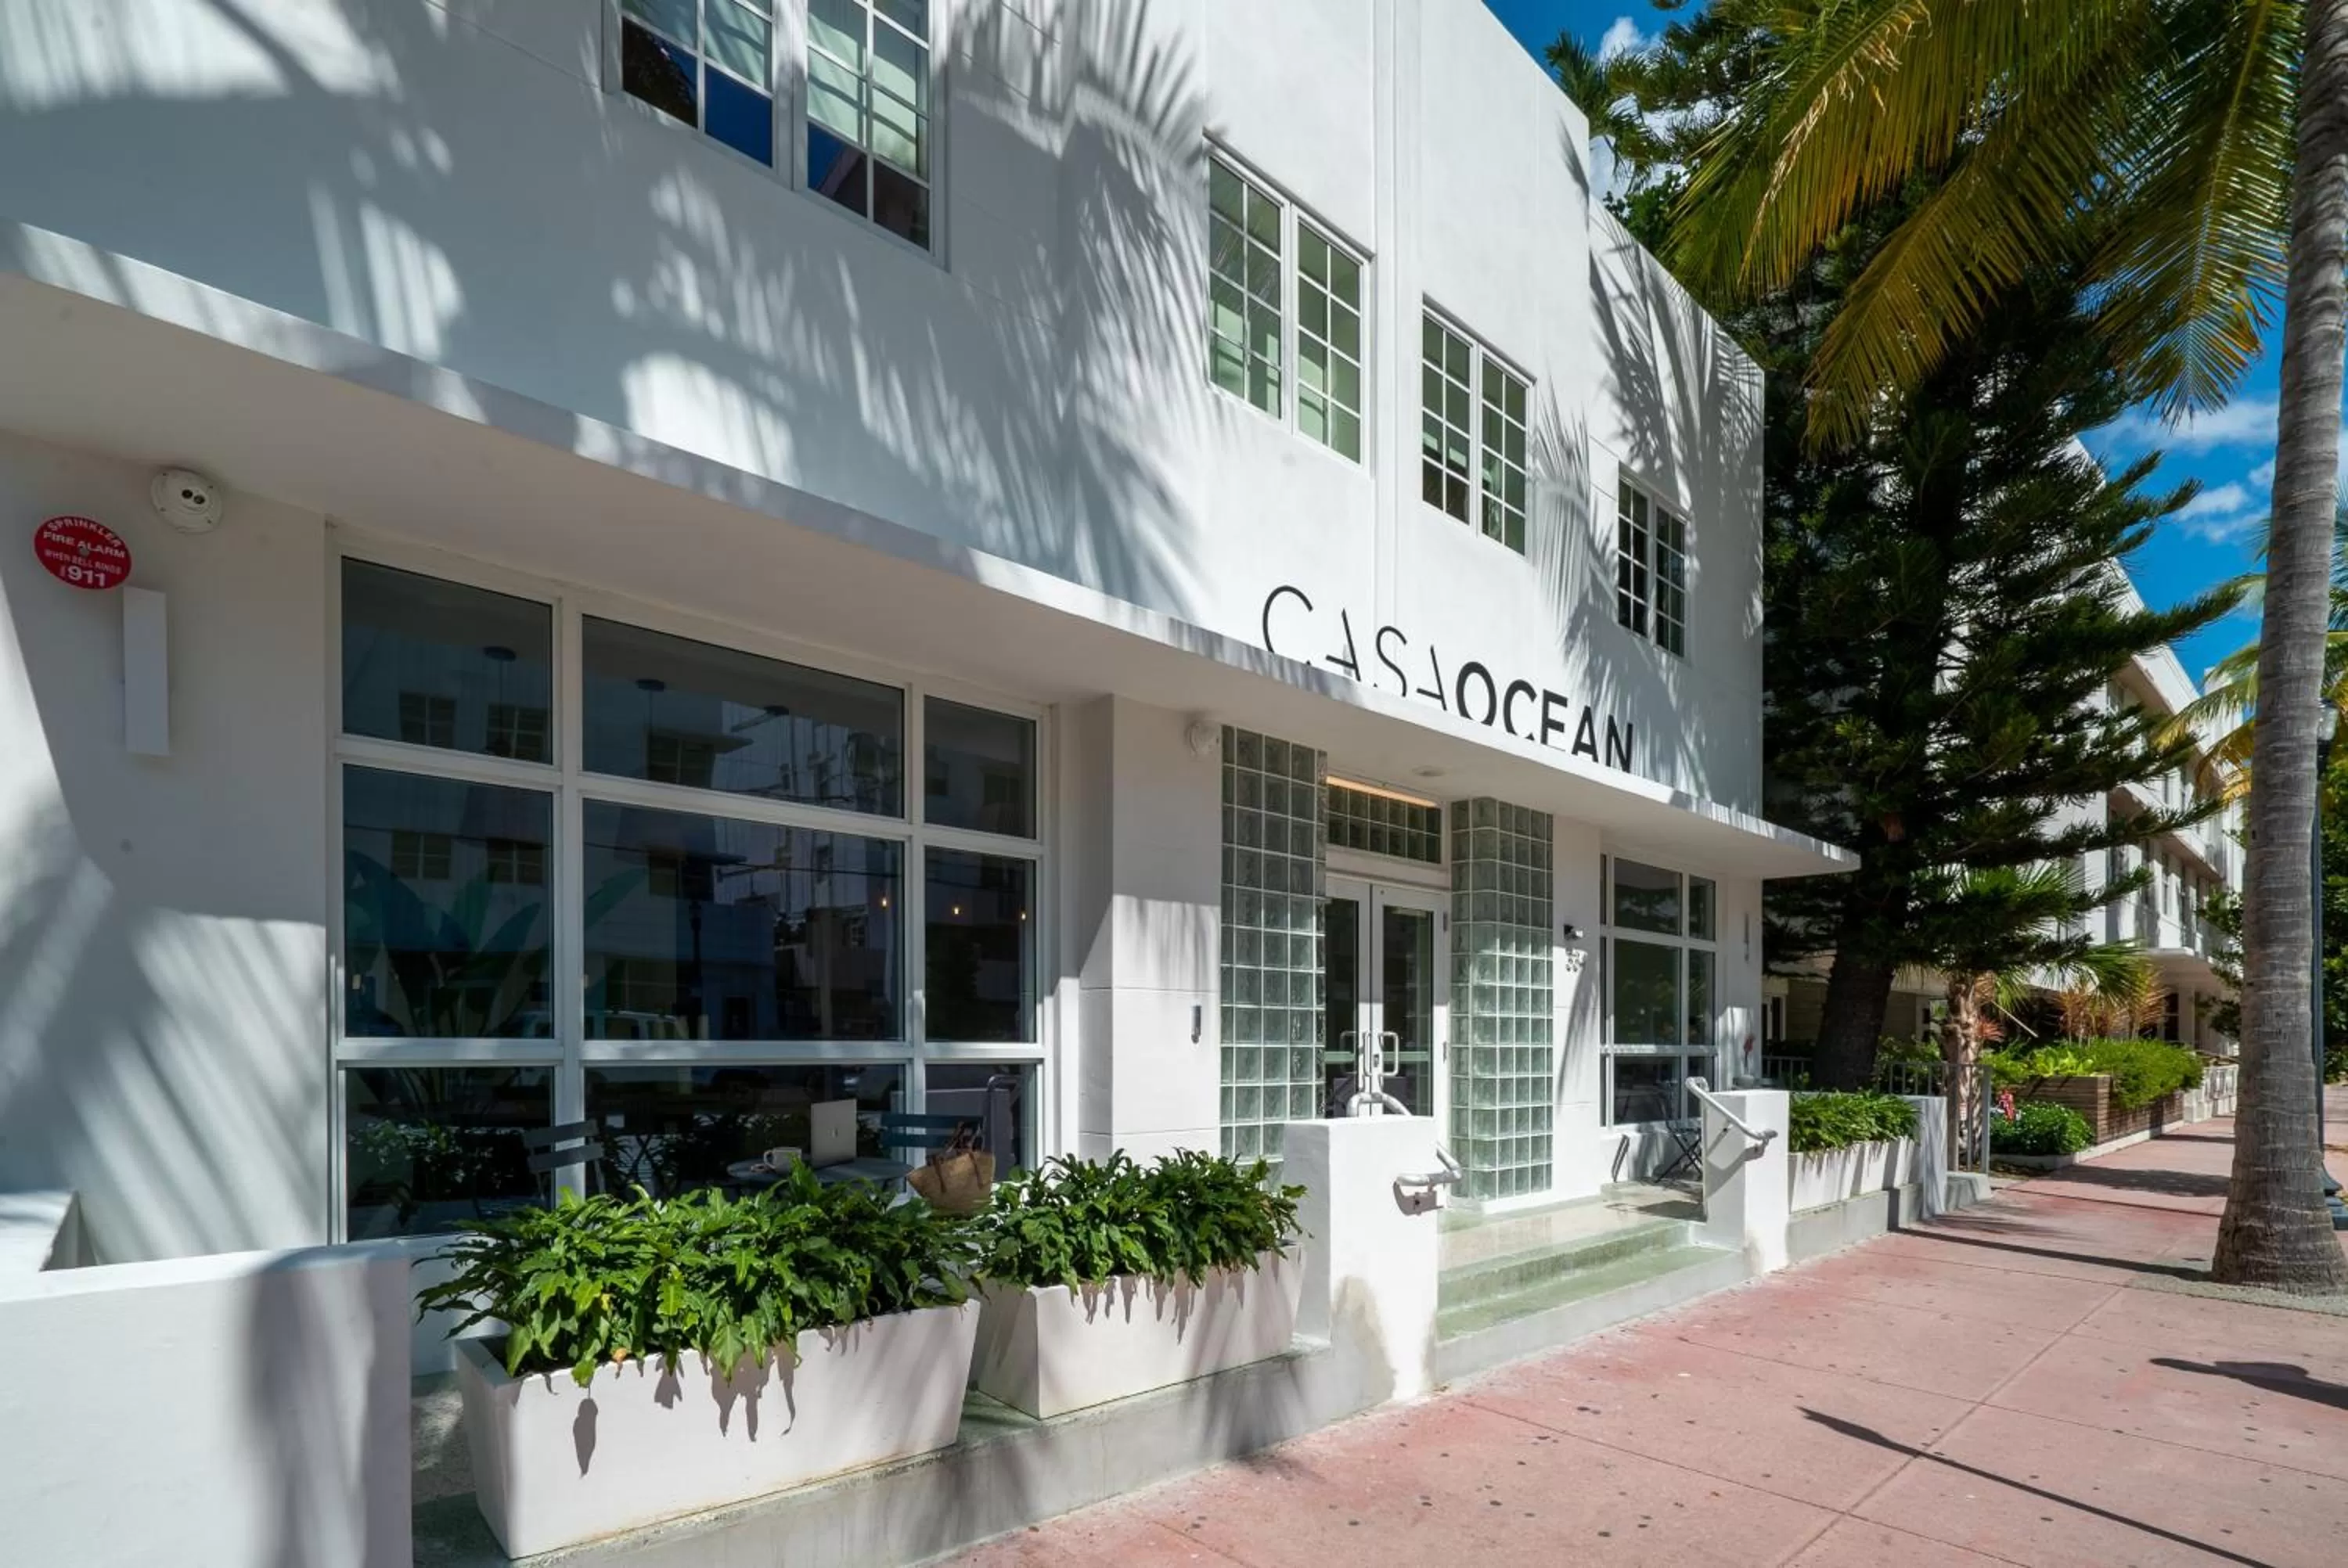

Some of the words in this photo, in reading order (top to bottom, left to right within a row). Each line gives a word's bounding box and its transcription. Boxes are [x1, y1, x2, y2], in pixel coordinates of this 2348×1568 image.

[43, 531, 75, 546] FIRE
[77, 541, 125, 559] ALARM
[47, 518, 121, 547] SPRINKLER
[44, 548, 70, 562] WHEN
[71, 556, 93, 567] BELL
[95, 561, 122, 575] RINGS
[67, 565, 106, 587] 911
